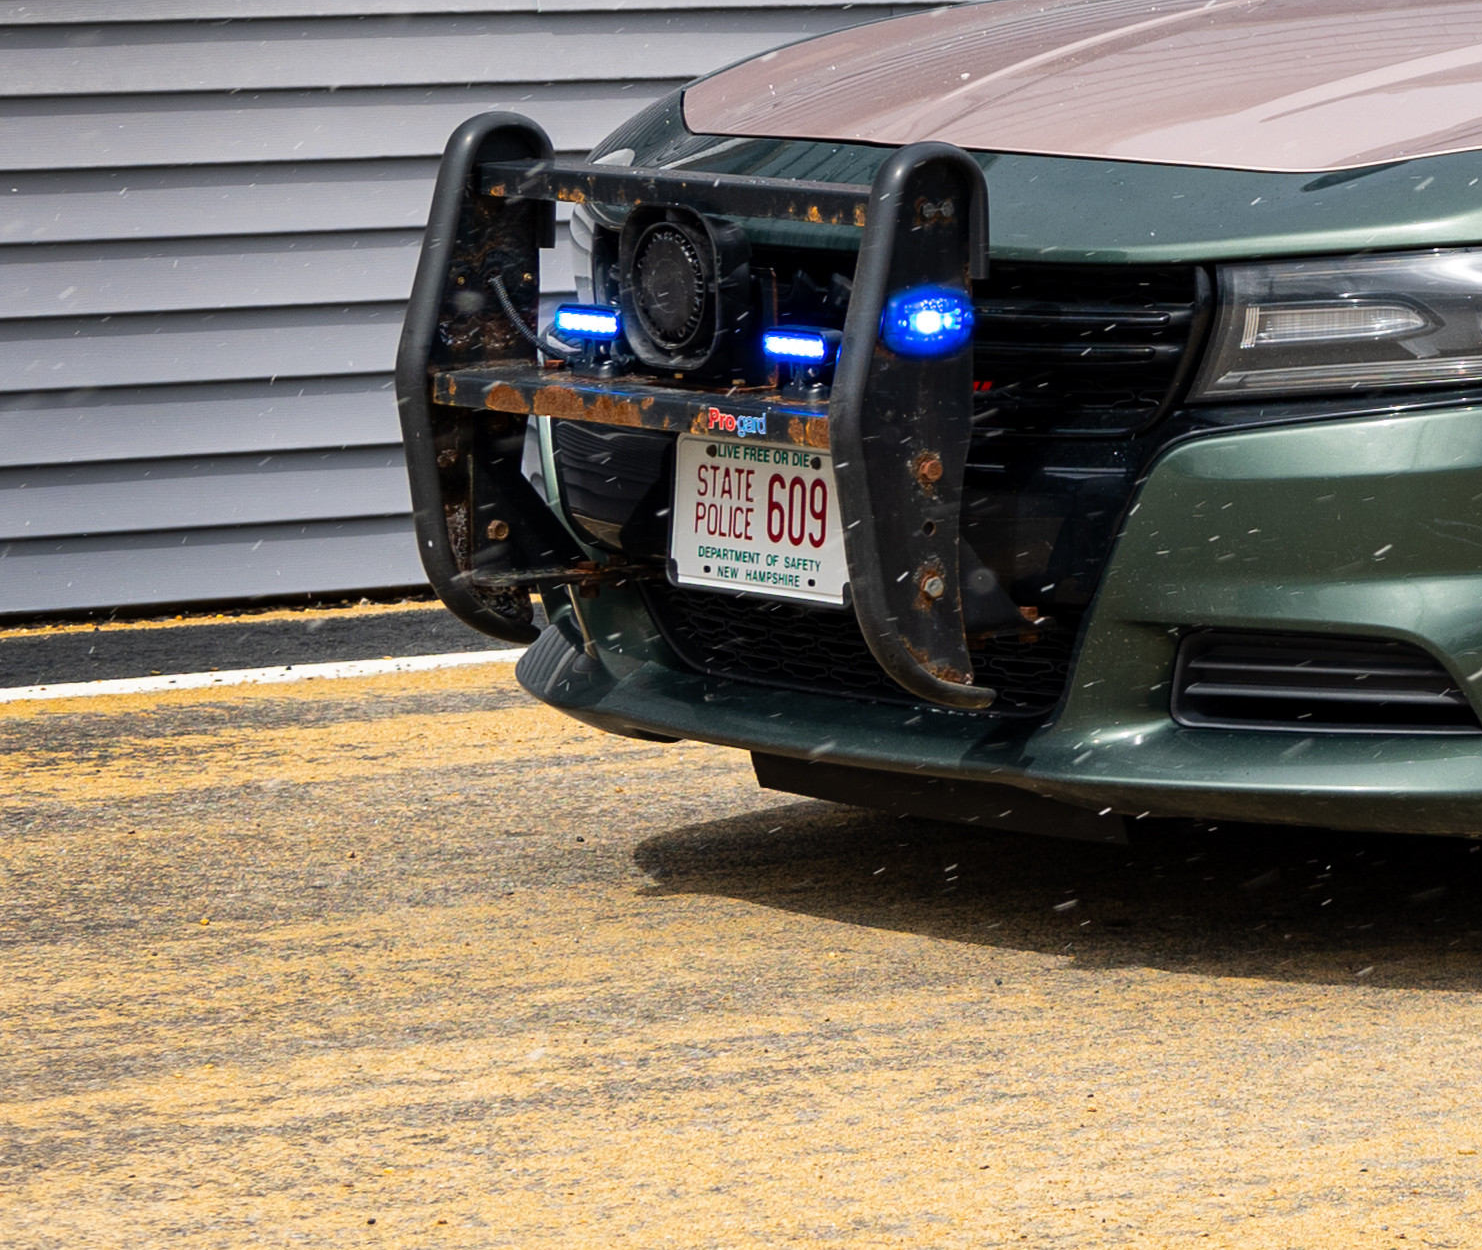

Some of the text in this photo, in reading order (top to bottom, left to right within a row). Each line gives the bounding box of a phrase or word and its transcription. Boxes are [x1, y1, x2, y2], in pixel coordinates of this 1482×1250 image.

[717, 444, 810, 467] LIVE FREE OR DIE
[697, 464, 755, 502] STATE
[694, 502, 754, 540] POLICE
[767, 473, 828, 548] 609
[698, 546, 821, 573] DEPARTMENT OF SAFETY
[717, 566, 800, 587] NEW HAMPSHIRE
